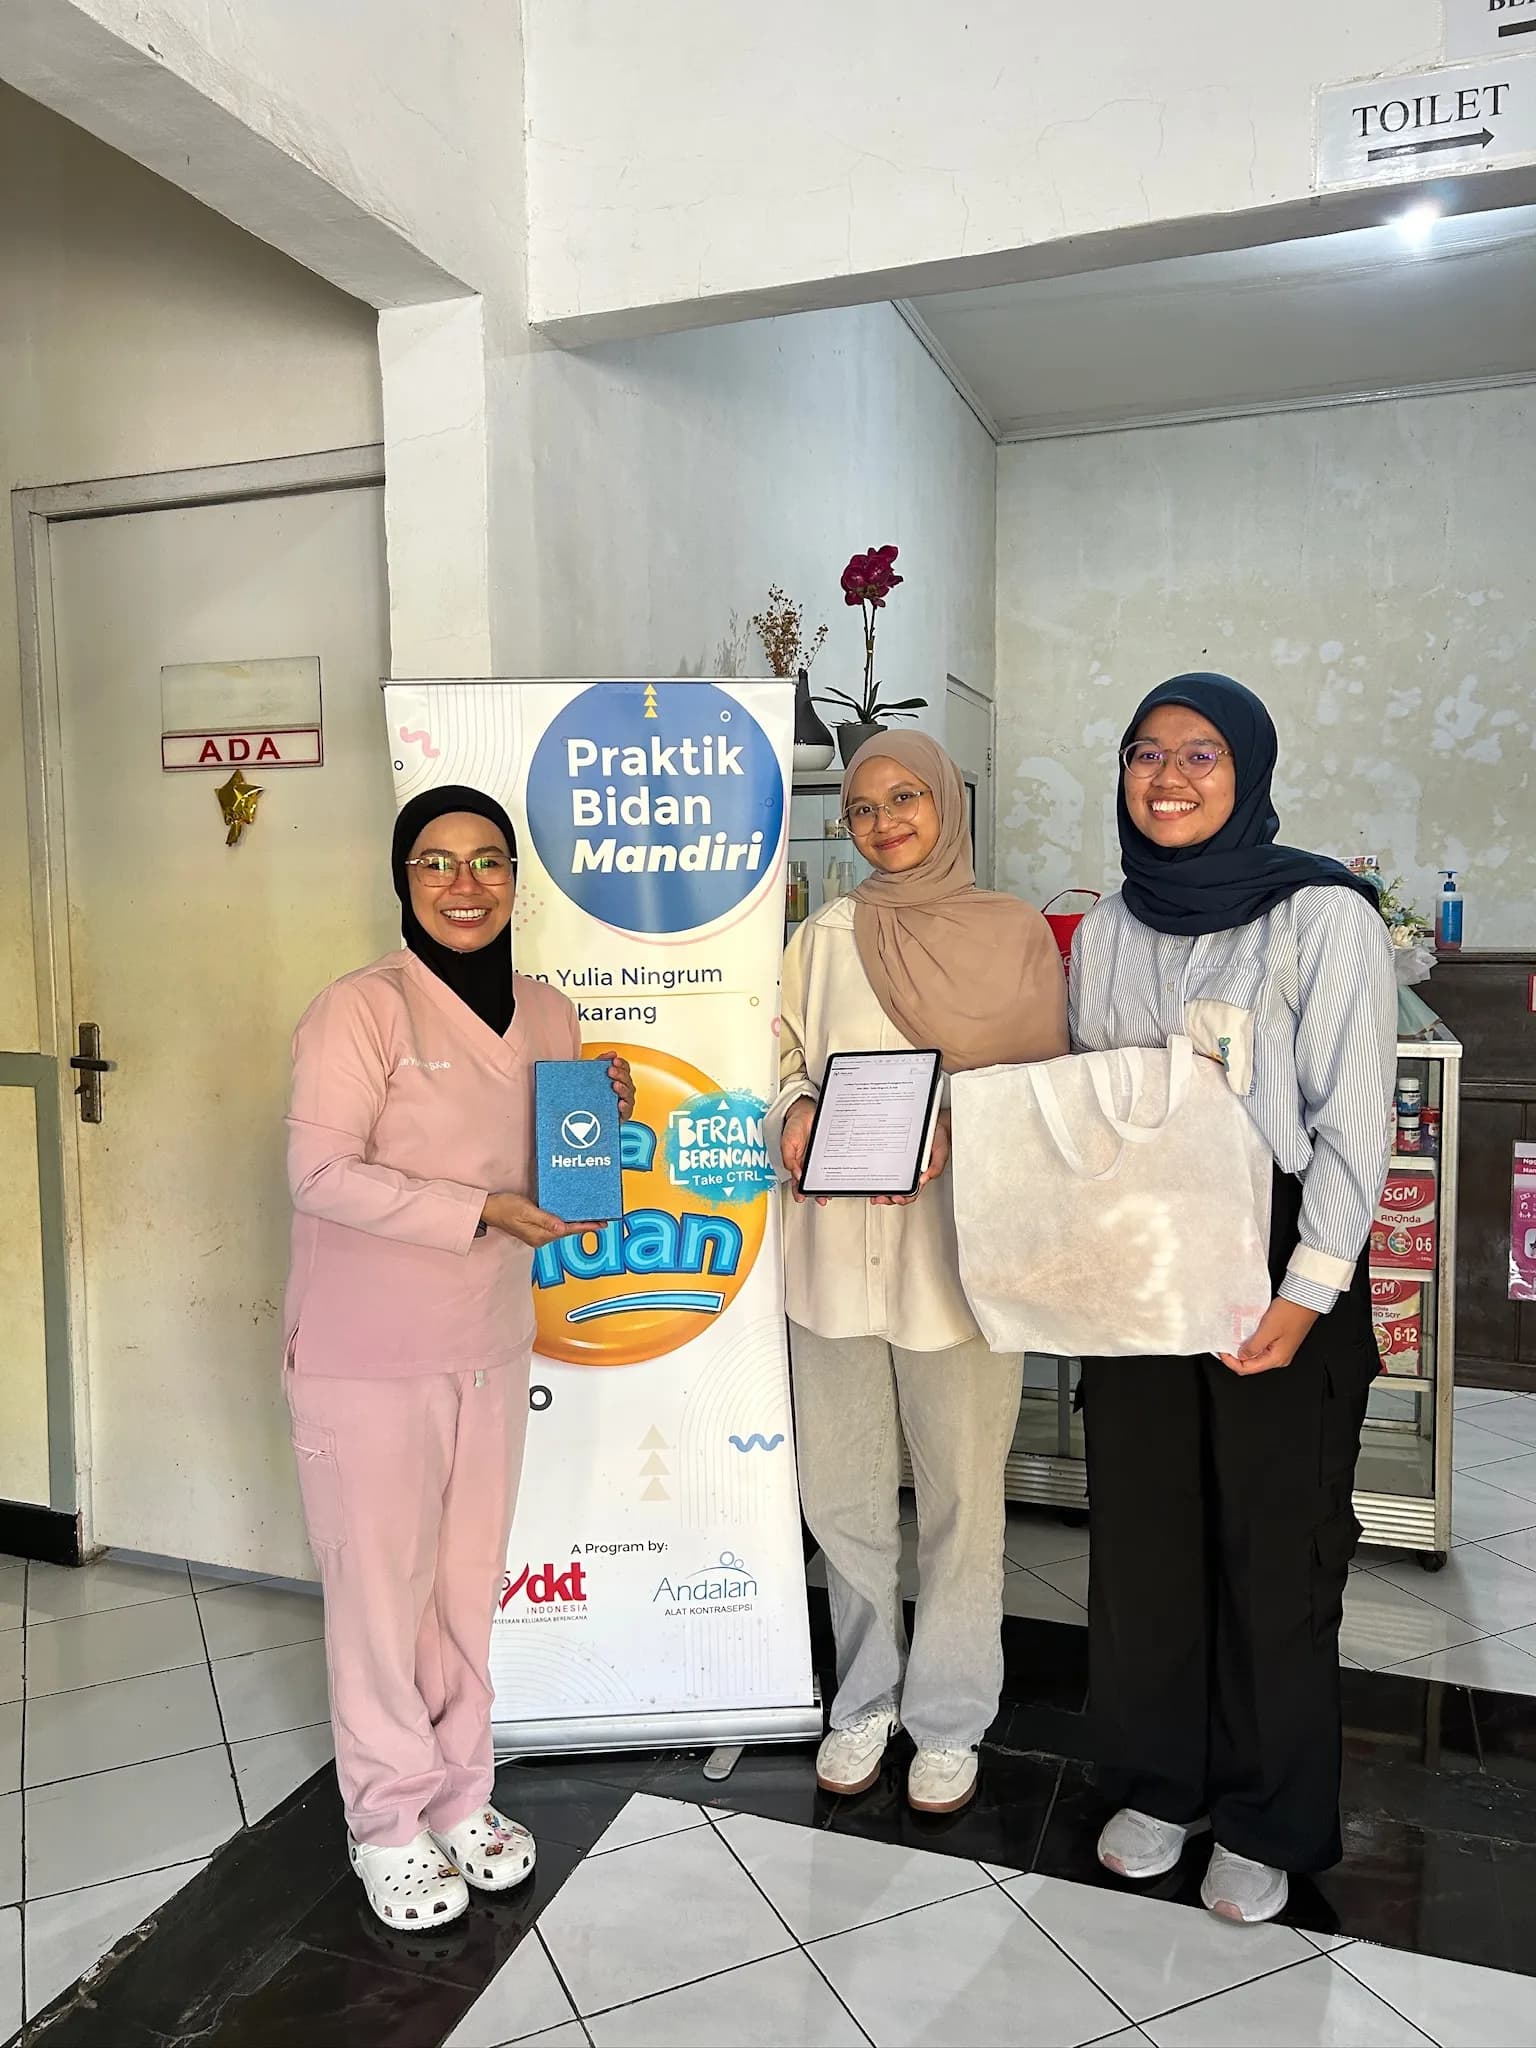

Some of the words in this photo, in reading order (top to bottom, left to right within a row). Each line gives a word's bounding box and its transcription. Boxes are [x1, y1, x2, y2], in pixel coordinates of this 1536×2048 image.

[1352, 83, 1510, 137] TOILET
[198, 736, 281, 763] ADA
[567, 734, 745, 778] Praktik
[572, 785, 712, 827] Bidan
[571, 831, 764, 874] Mandiri
[556, 967, 613, 987] Yulia
[621, 966, 723, 989] Ningrum
[551, 1154, 612, 1168] HerLens
[692, 1174, 723, 1186] Take
[726, 1170, 763, 1183] CTRL
[1383, 1186, 1418, 1202] SGM
[570, 1544, 582, 1555] A
[585, 1542, 644, 1556] Program
[648, 1540, 668, 1554] by:
[526, 1562, 587, 1604] dkt
[652, 1576, 758, 1602] Andalan
[526, 1604, 589, 1615] INDONESIA
[664, 1608, 688, 1617] ALAT
[689, 1603, 753, 1615] KONTRASEPSI
